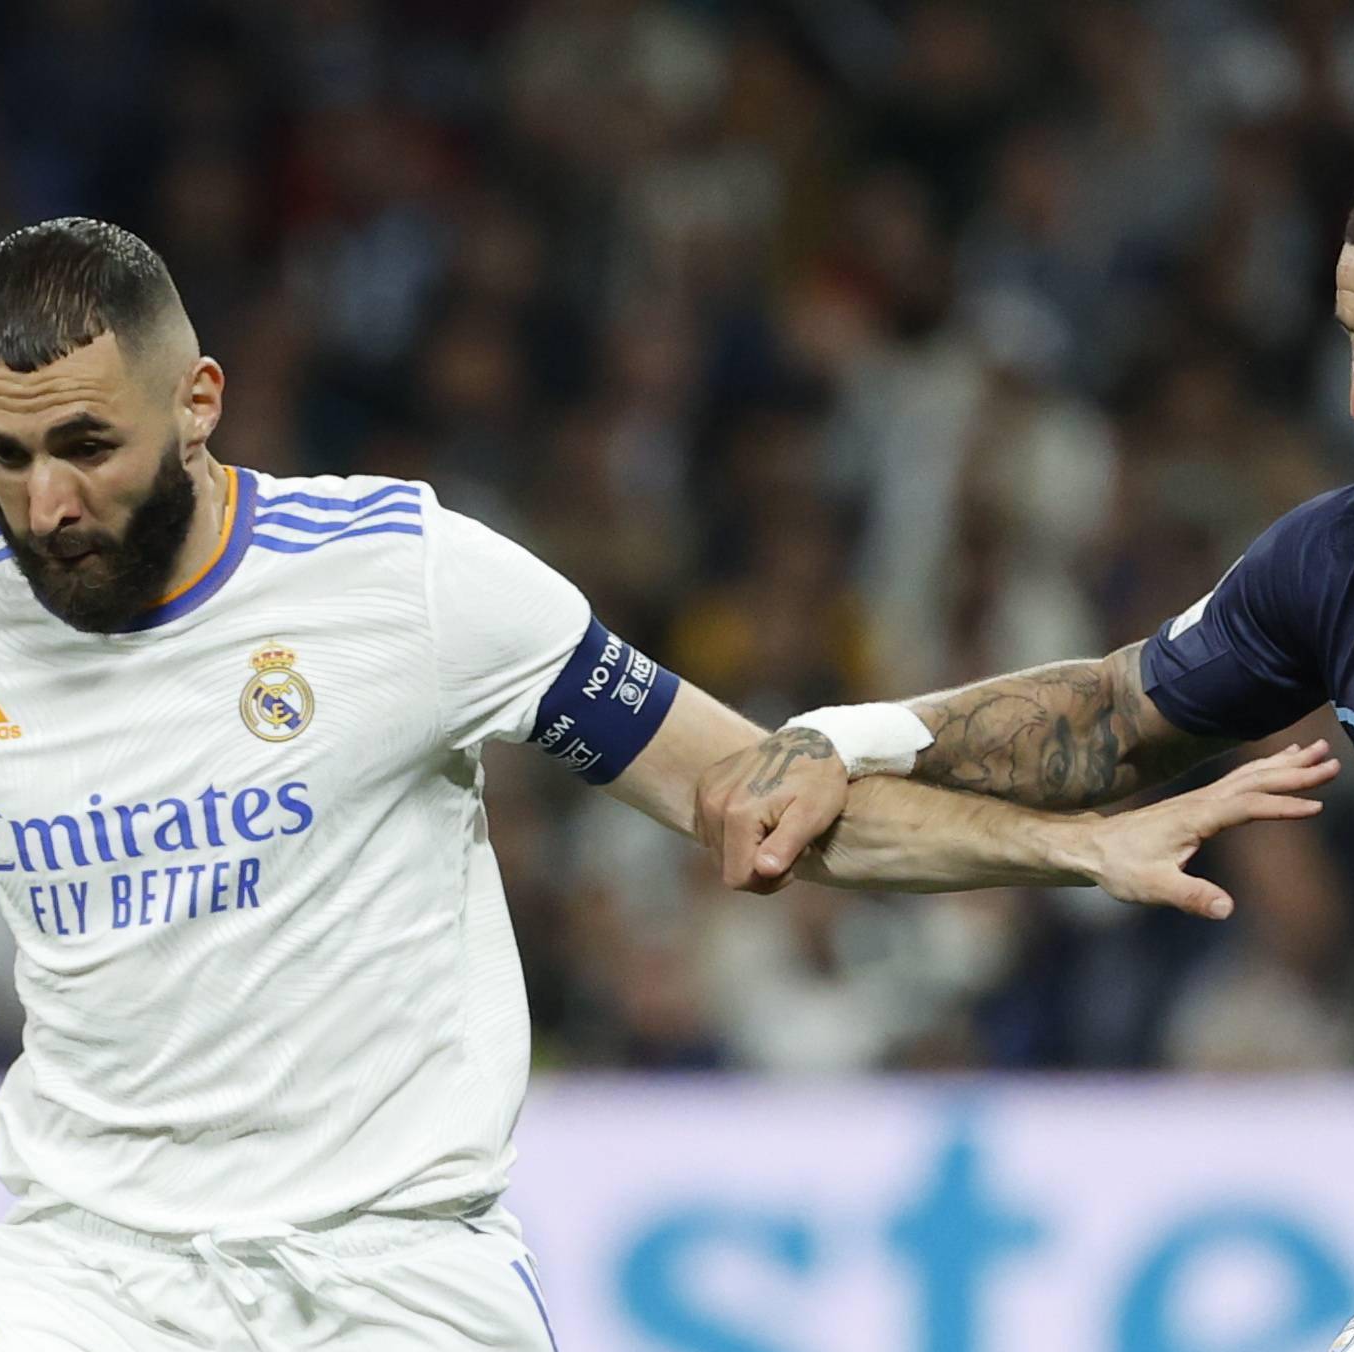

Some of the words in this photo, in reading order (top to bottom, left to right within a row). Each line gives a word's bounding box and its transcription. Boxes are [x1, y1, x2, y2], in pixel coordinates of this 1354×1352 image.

[582, 666, 610, 699] NO
[30, 881, 88, 936] FLY
[111, 857, 261, 930] BETTER
